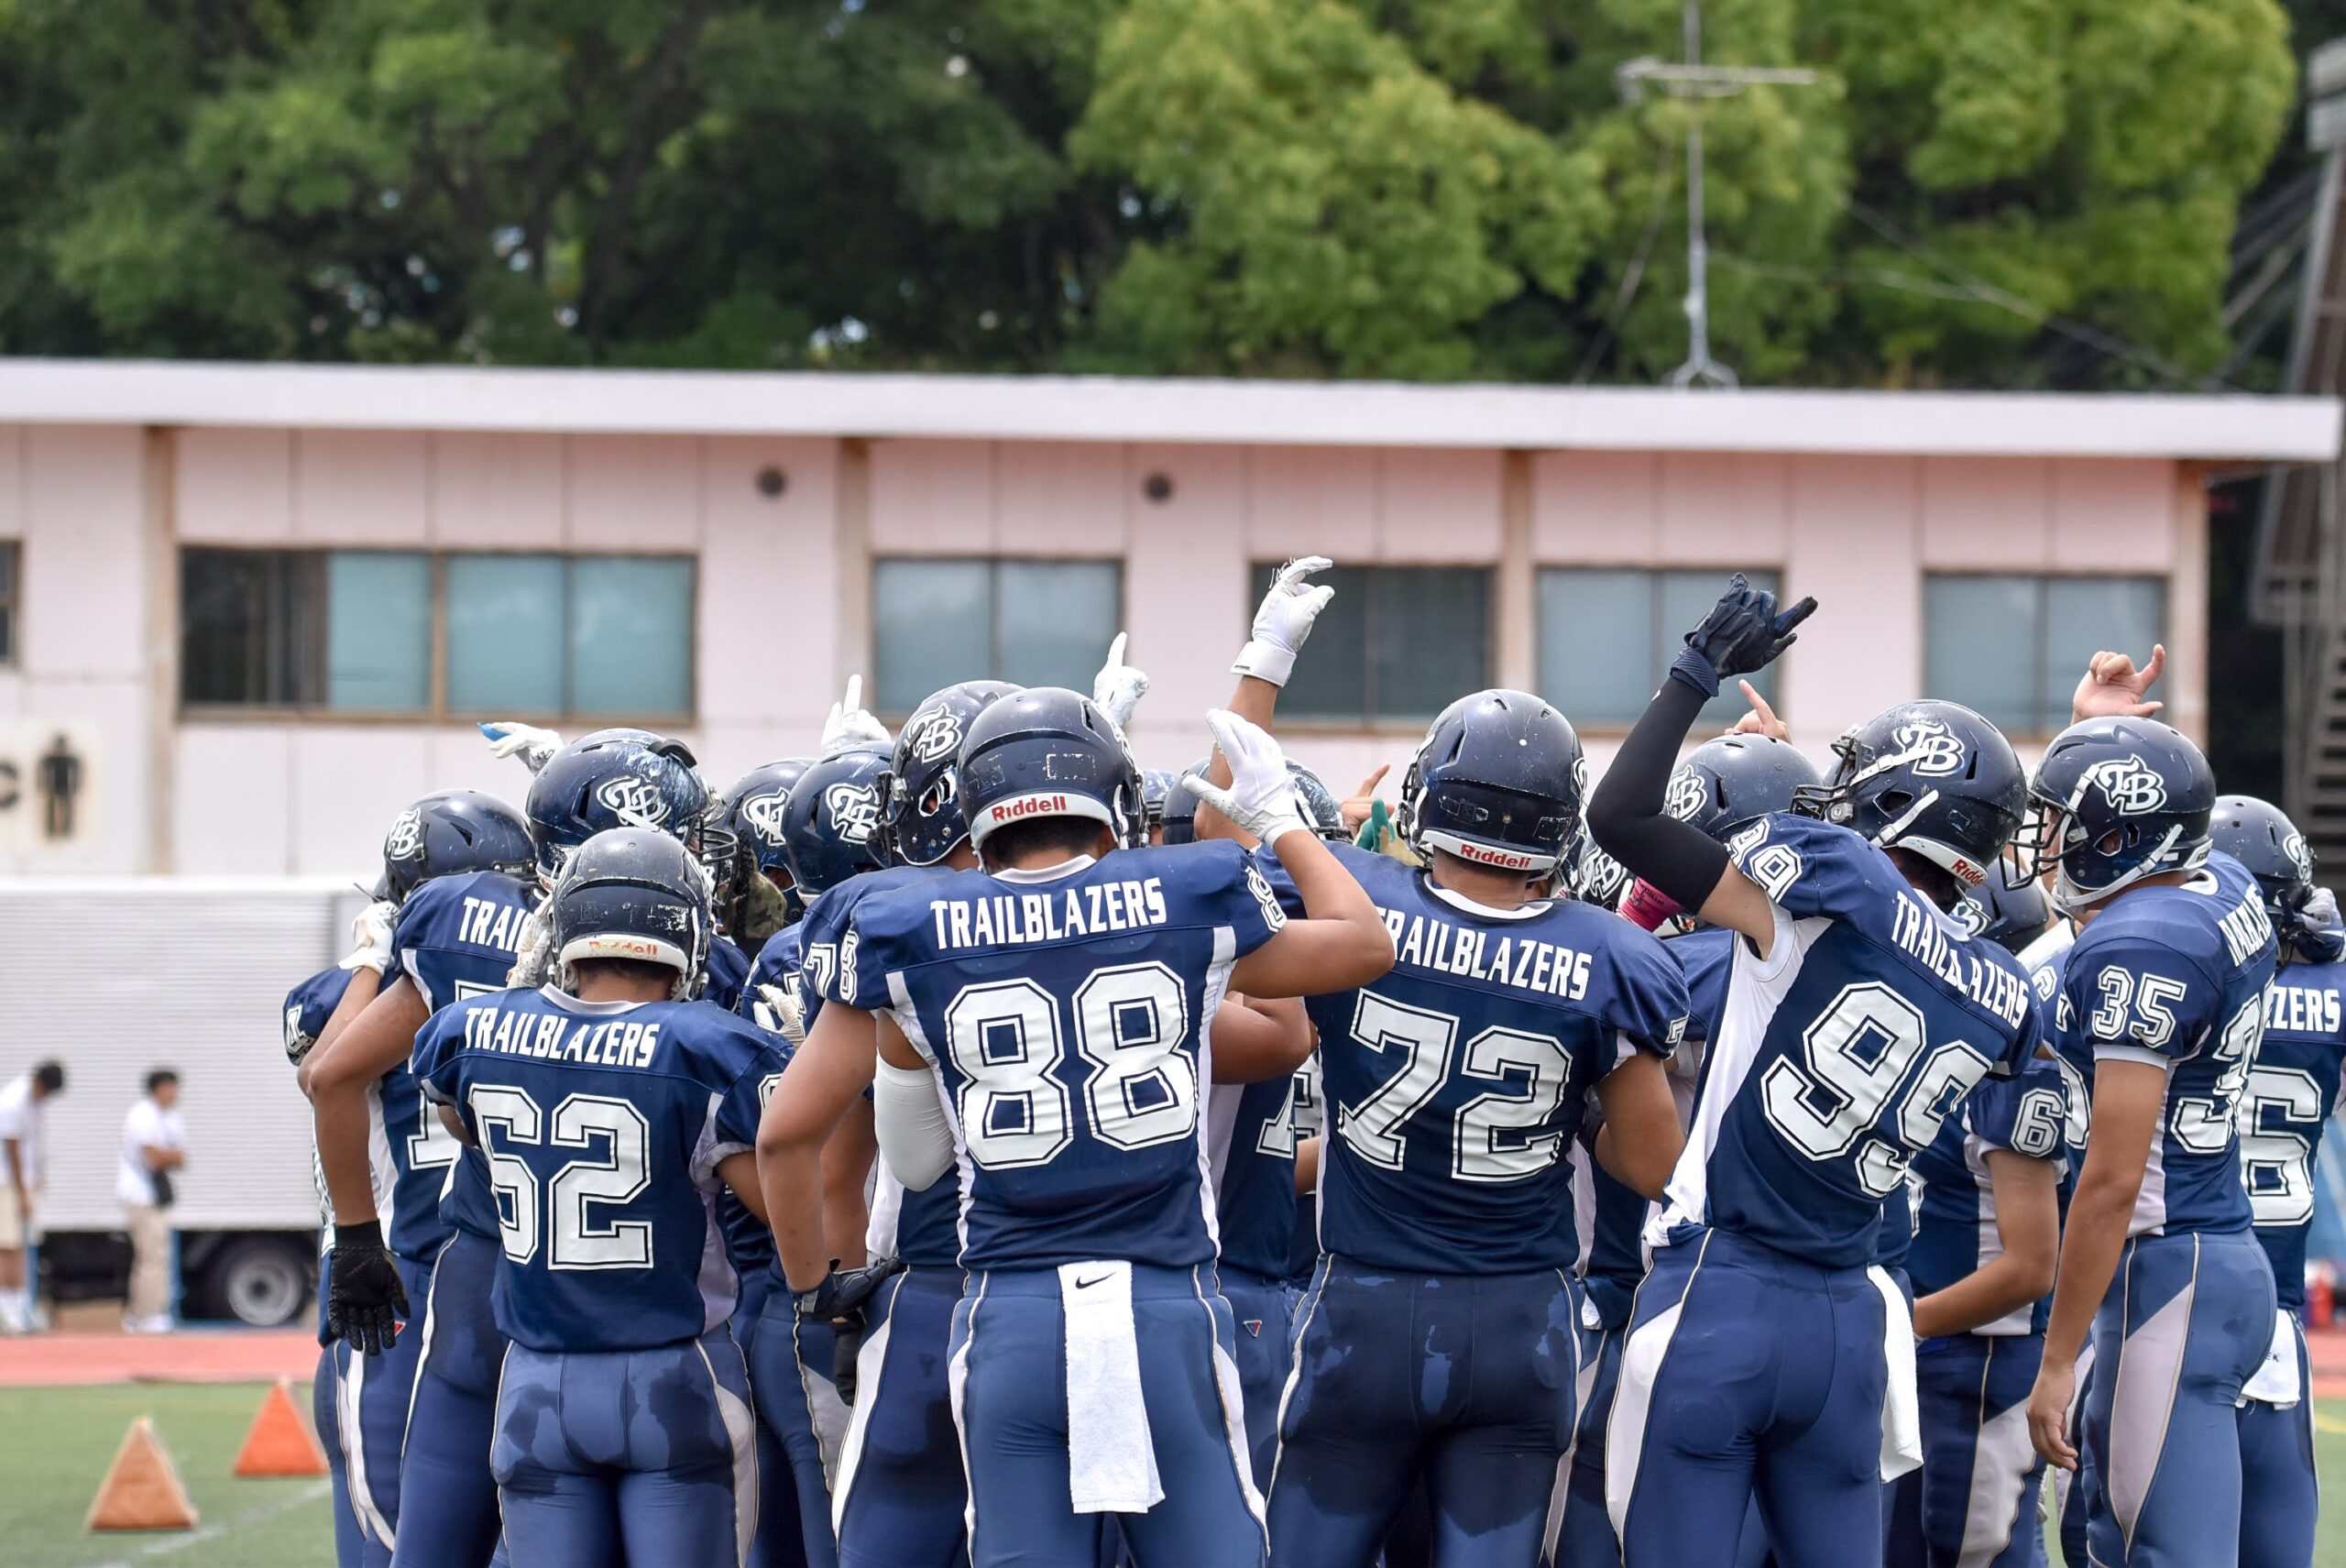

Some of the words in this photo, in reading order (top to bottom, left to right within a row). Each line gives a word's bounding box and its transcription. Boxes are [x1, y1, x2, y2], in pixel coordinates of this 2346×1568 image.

[992, 795, 1066, 822] Riddell
[2093, 753, 2166, 816] TB
[1461, 843, 1532, 869] Riddell
[930, 877, 1168, 949] TRAILBLAZERS
[465, 1007, 661, 1069] TRAILBLAZERS
[2091, 965, 2187, 1049] 35
[945, 960, 1200, 1171] 88
[1338, 988, 1573, 1182] 72
[2011, 1088, 2065, 1158] 6
[468, 1082, 654, 1271] 62
